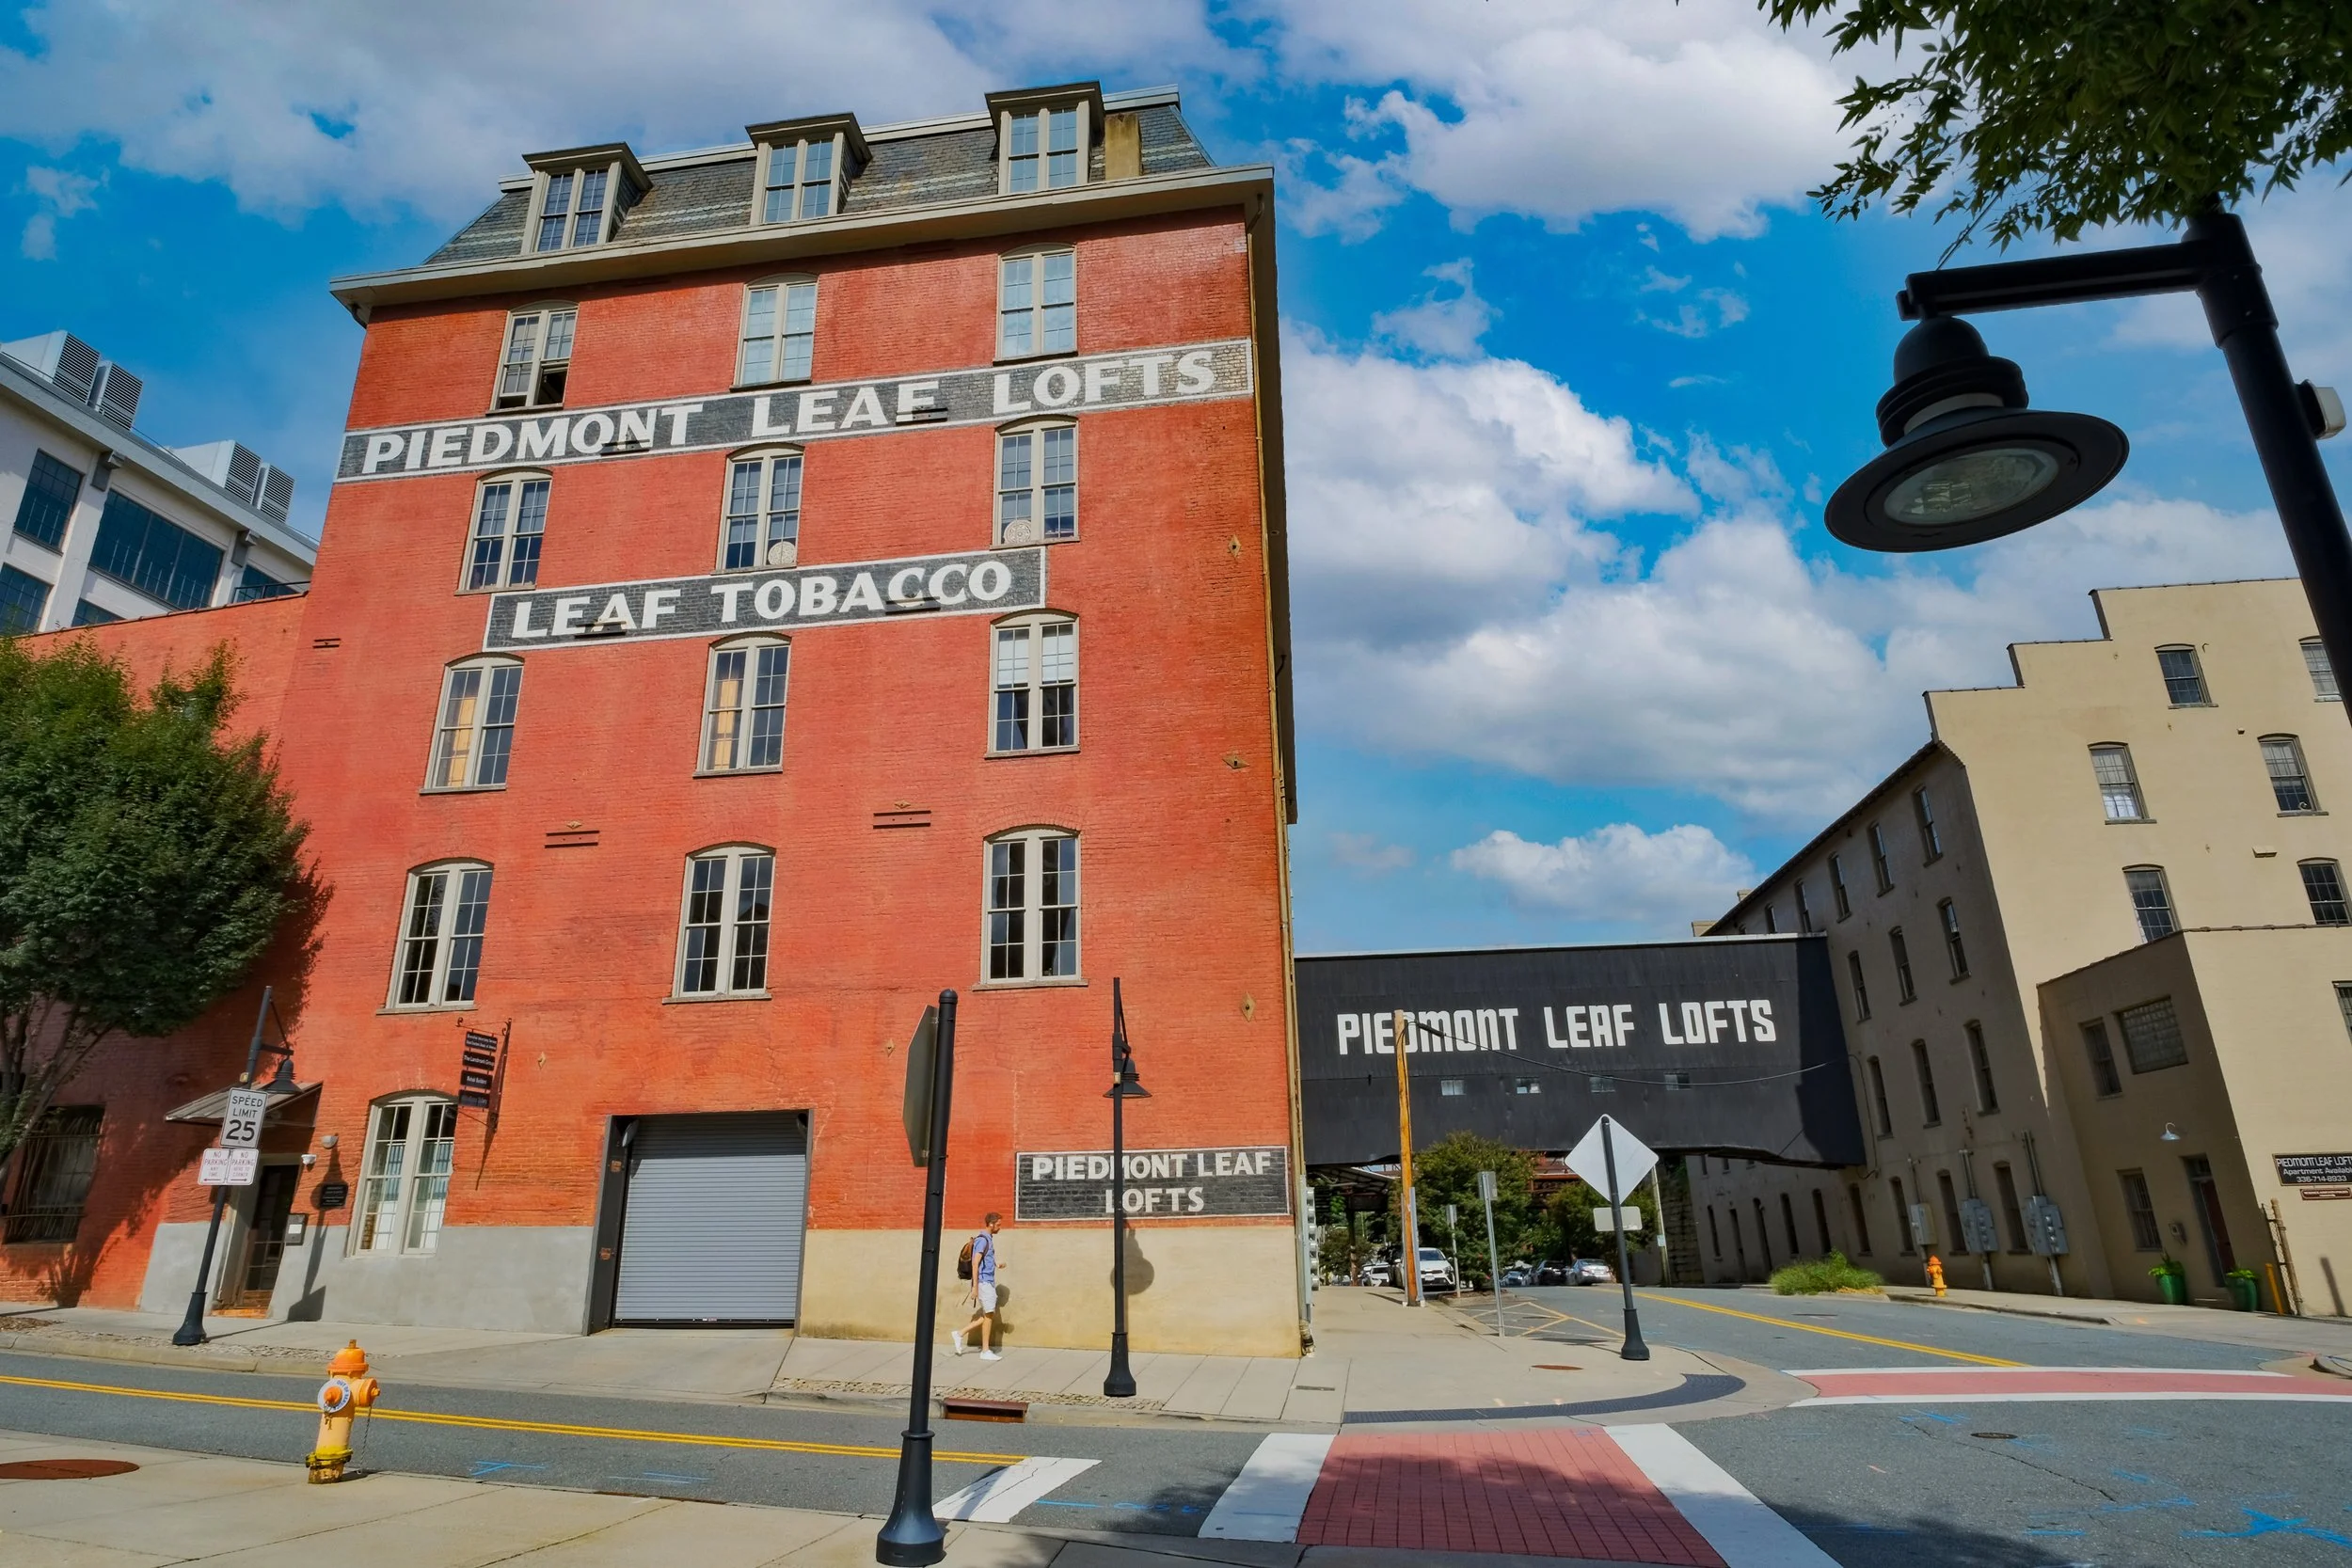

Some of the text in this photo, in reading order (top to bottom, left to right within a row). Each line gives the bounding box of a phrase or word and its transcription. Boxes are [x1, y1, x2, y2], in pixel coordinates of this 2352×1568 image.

[361, 350, 1215, 474] PIEDMONT LEAF LOFTS
[511, 562, 1012, 639] LEAF TOBACCO
[1337, 999, 1776, 1055] PIEDMONT LEAF LOFTS
[231, 1095, 262, 1107] SPEED
[232, 1108, 258, 1118] LIMIT
[226, 1119, 256, 1141] 25
[204, 1158, 228, 1166] PARKING
[1032, 1151, 1271, 1180] PIEDMONT LEAF
[2276, 1156, 2352, 1167] PIEDMONT LEAF LOFT
[1105, 1186, 1204, 1213] LOFTS
